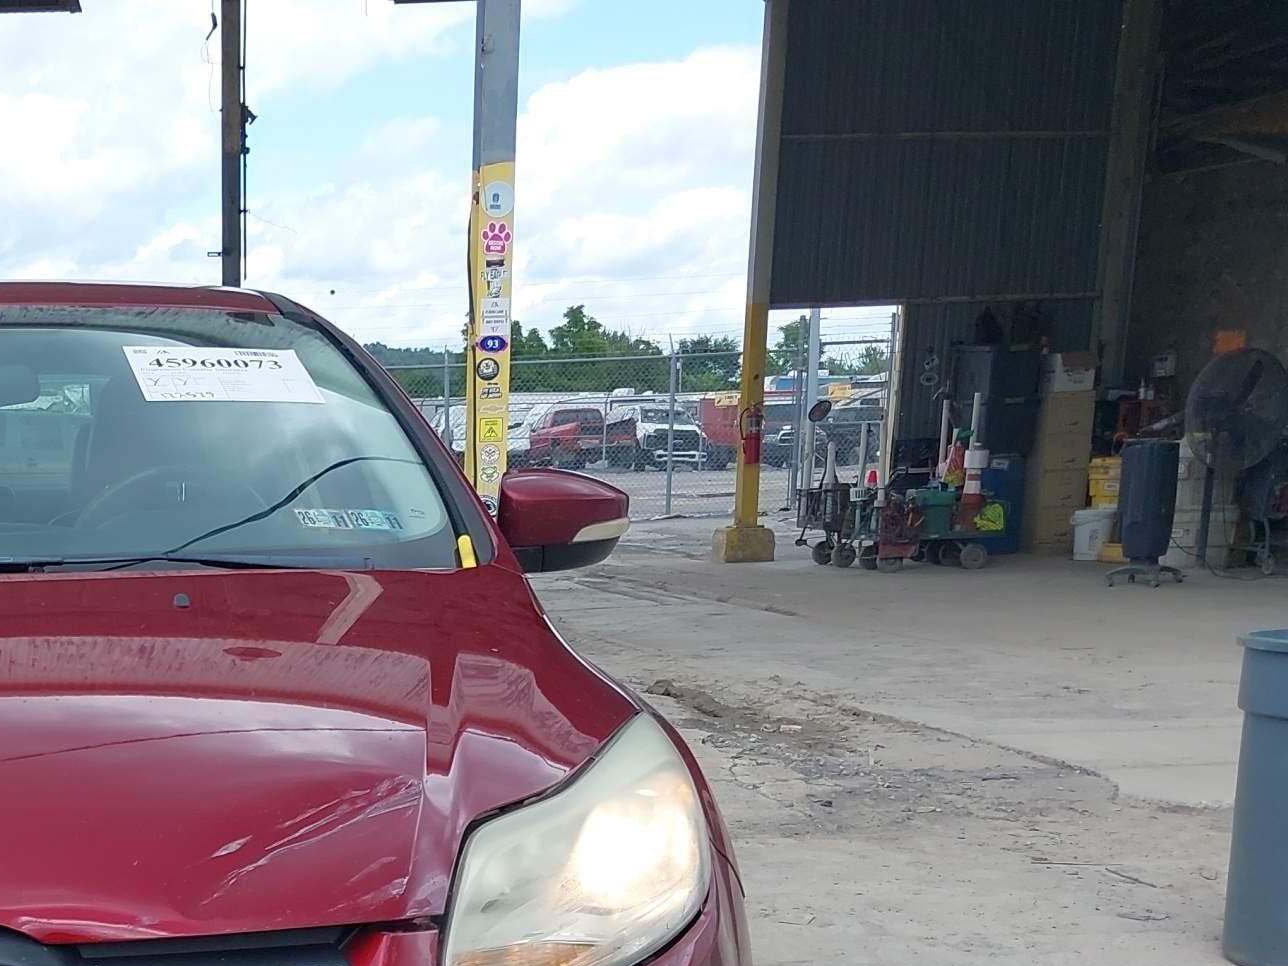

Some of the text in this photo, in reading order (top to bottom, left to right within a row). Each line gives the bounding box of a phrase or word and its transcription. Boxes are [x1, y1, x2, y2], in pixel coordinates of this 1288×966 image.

[487, 339, 499, 348] 93
[149, 357, 283, 370] 45960073
[297, 511, 316, 525] 26
[350, 511, 369, 527] 26
